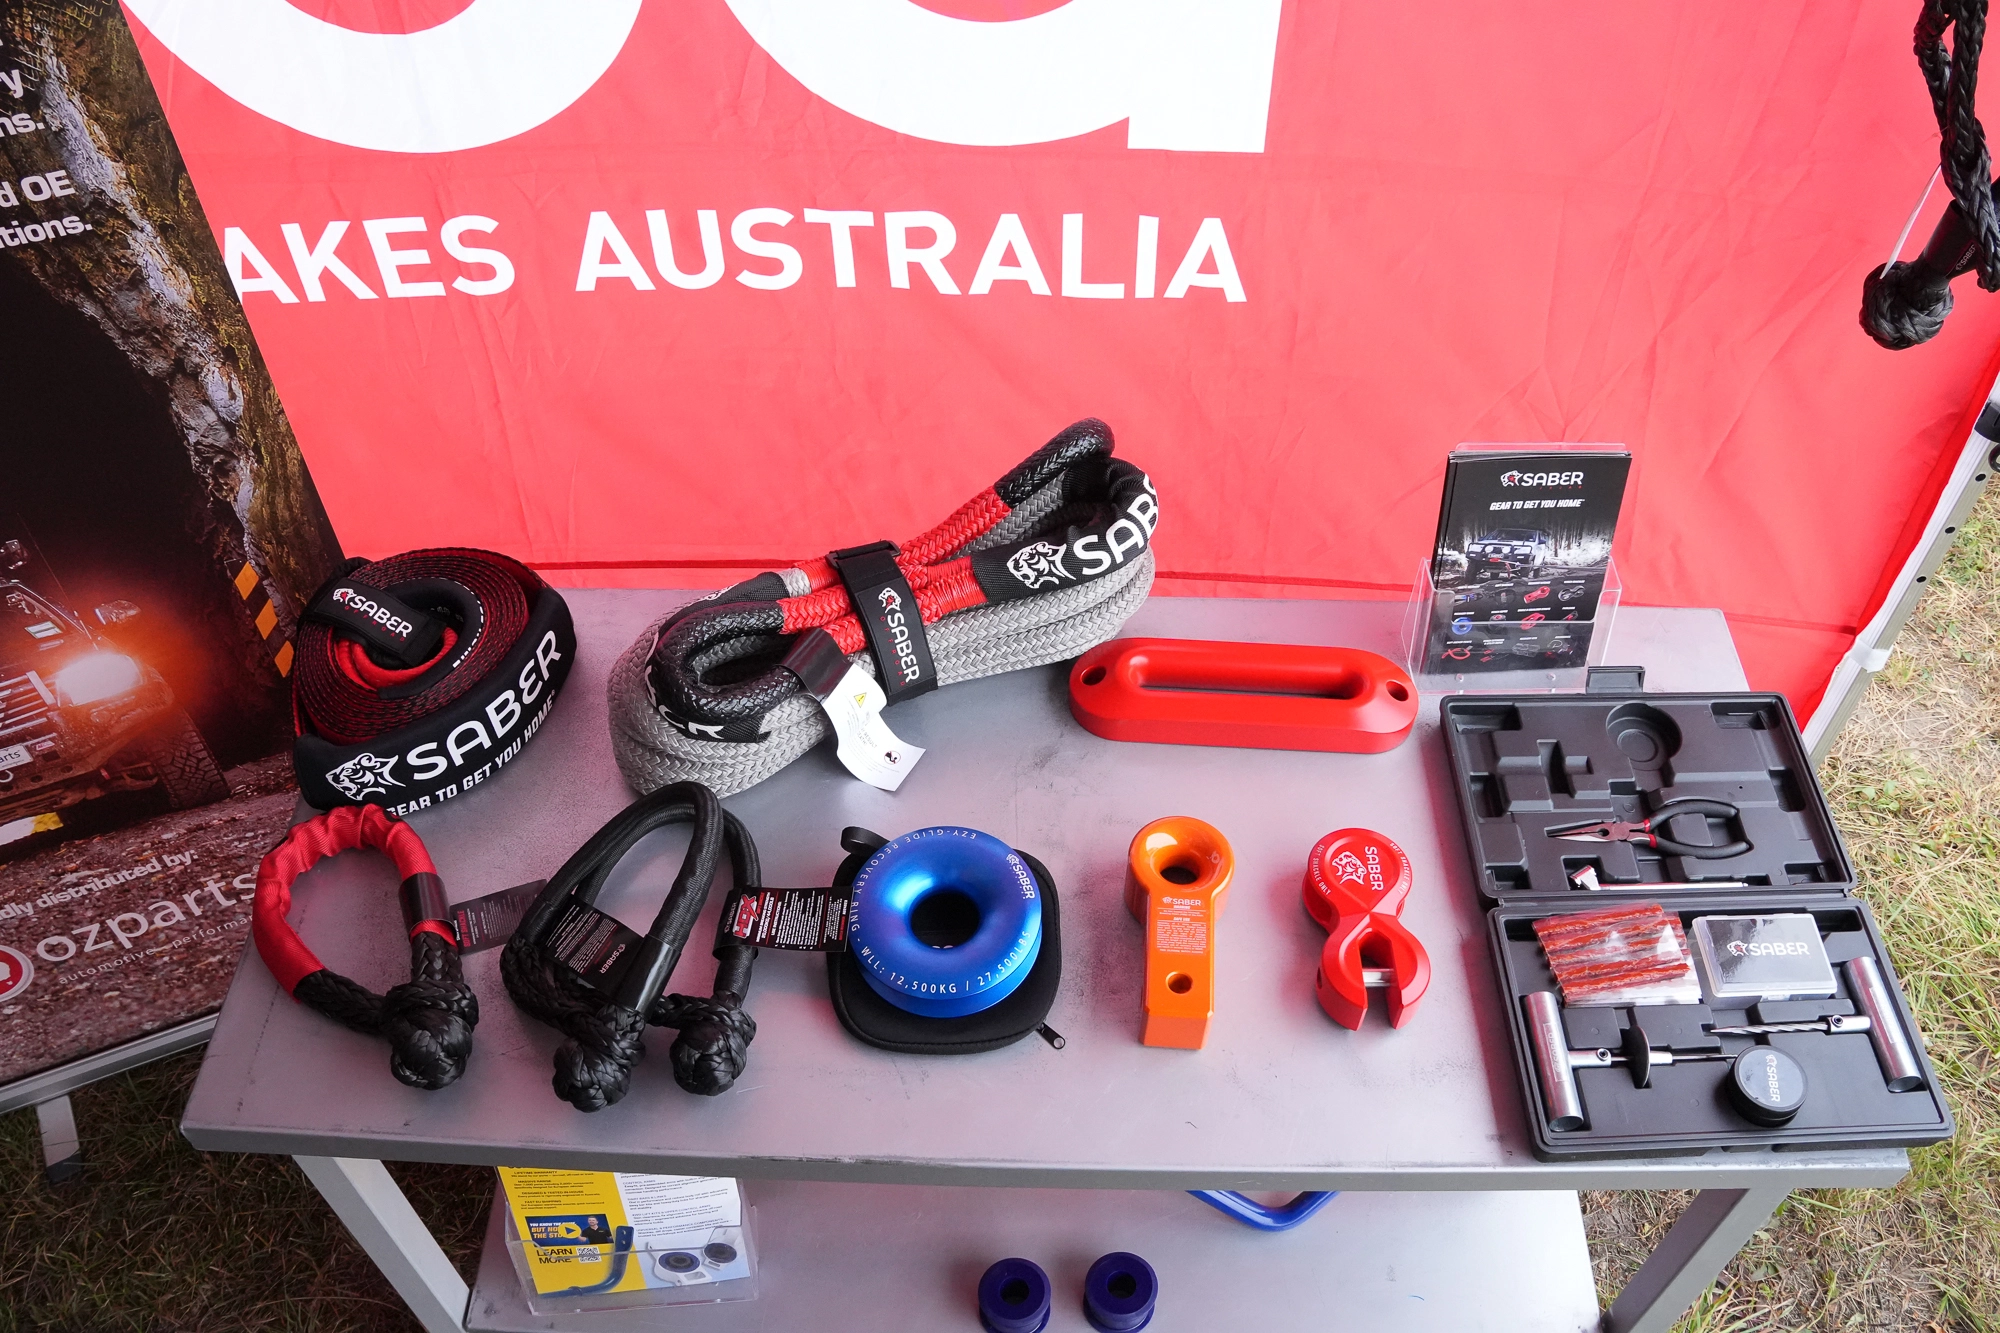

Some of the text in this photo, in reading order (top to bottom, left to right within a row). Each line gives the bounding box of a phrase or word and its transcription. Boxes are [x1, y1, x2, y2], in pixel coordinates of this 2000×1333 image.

[0, 69, 24, 99] y
[20, 170, 76, 201] OE
[575, 207, 1248, 303] AUSTRALIA
[1520, 471, 1584, 487] SABER
[1489, 502, 1512, 511] GEAR
[1512, 501, 1524, 510] TO
[1523, 500, 1541, 509] GET
[1540, 500, 1557, 508] YOU
[349, 595, 413, 638] SABER
[887, 612, 920, 683] SABER
[406, 630, 562, 781] SABER
[435, 783, 459, 803] TO
[462, 762, 493, 792] GET
[495, 737, 522, 769] YOU
[904, 828, 977, 844] EZY-GLIDE
[0, 848, 199, 921] dly distributed by:
[855, 841, 899, 894] RECOVERY
[1012, 863, 1036, 900] SABER
[1312, 857, 1322, 882] SHACKLE
[1318, 881, 1332, 895] ONLY
[1364, 845, 1384, 891] SABER
[36, 873, 256, 961] ozparts
[735, 894, 759, 938] HDX
[850, 901, 861, 932] RING
[1172, 898, 1202, 906] SABER
[59, 948, 155, 984] automotive
[600, 949, 620, 974] SABER
[861, 945, 886, 974] WLL:
[977, 930, 1031, 986] 27,500LBS
[1750, 942, 1811, 956] SABER
[890, 972, 957, 994] 12,500KG
[1766, 1066, 1780, 1102] SABER
[536, 1248, 573, 1257] LEARN
[538, 1256, 572, 1264] MORE
